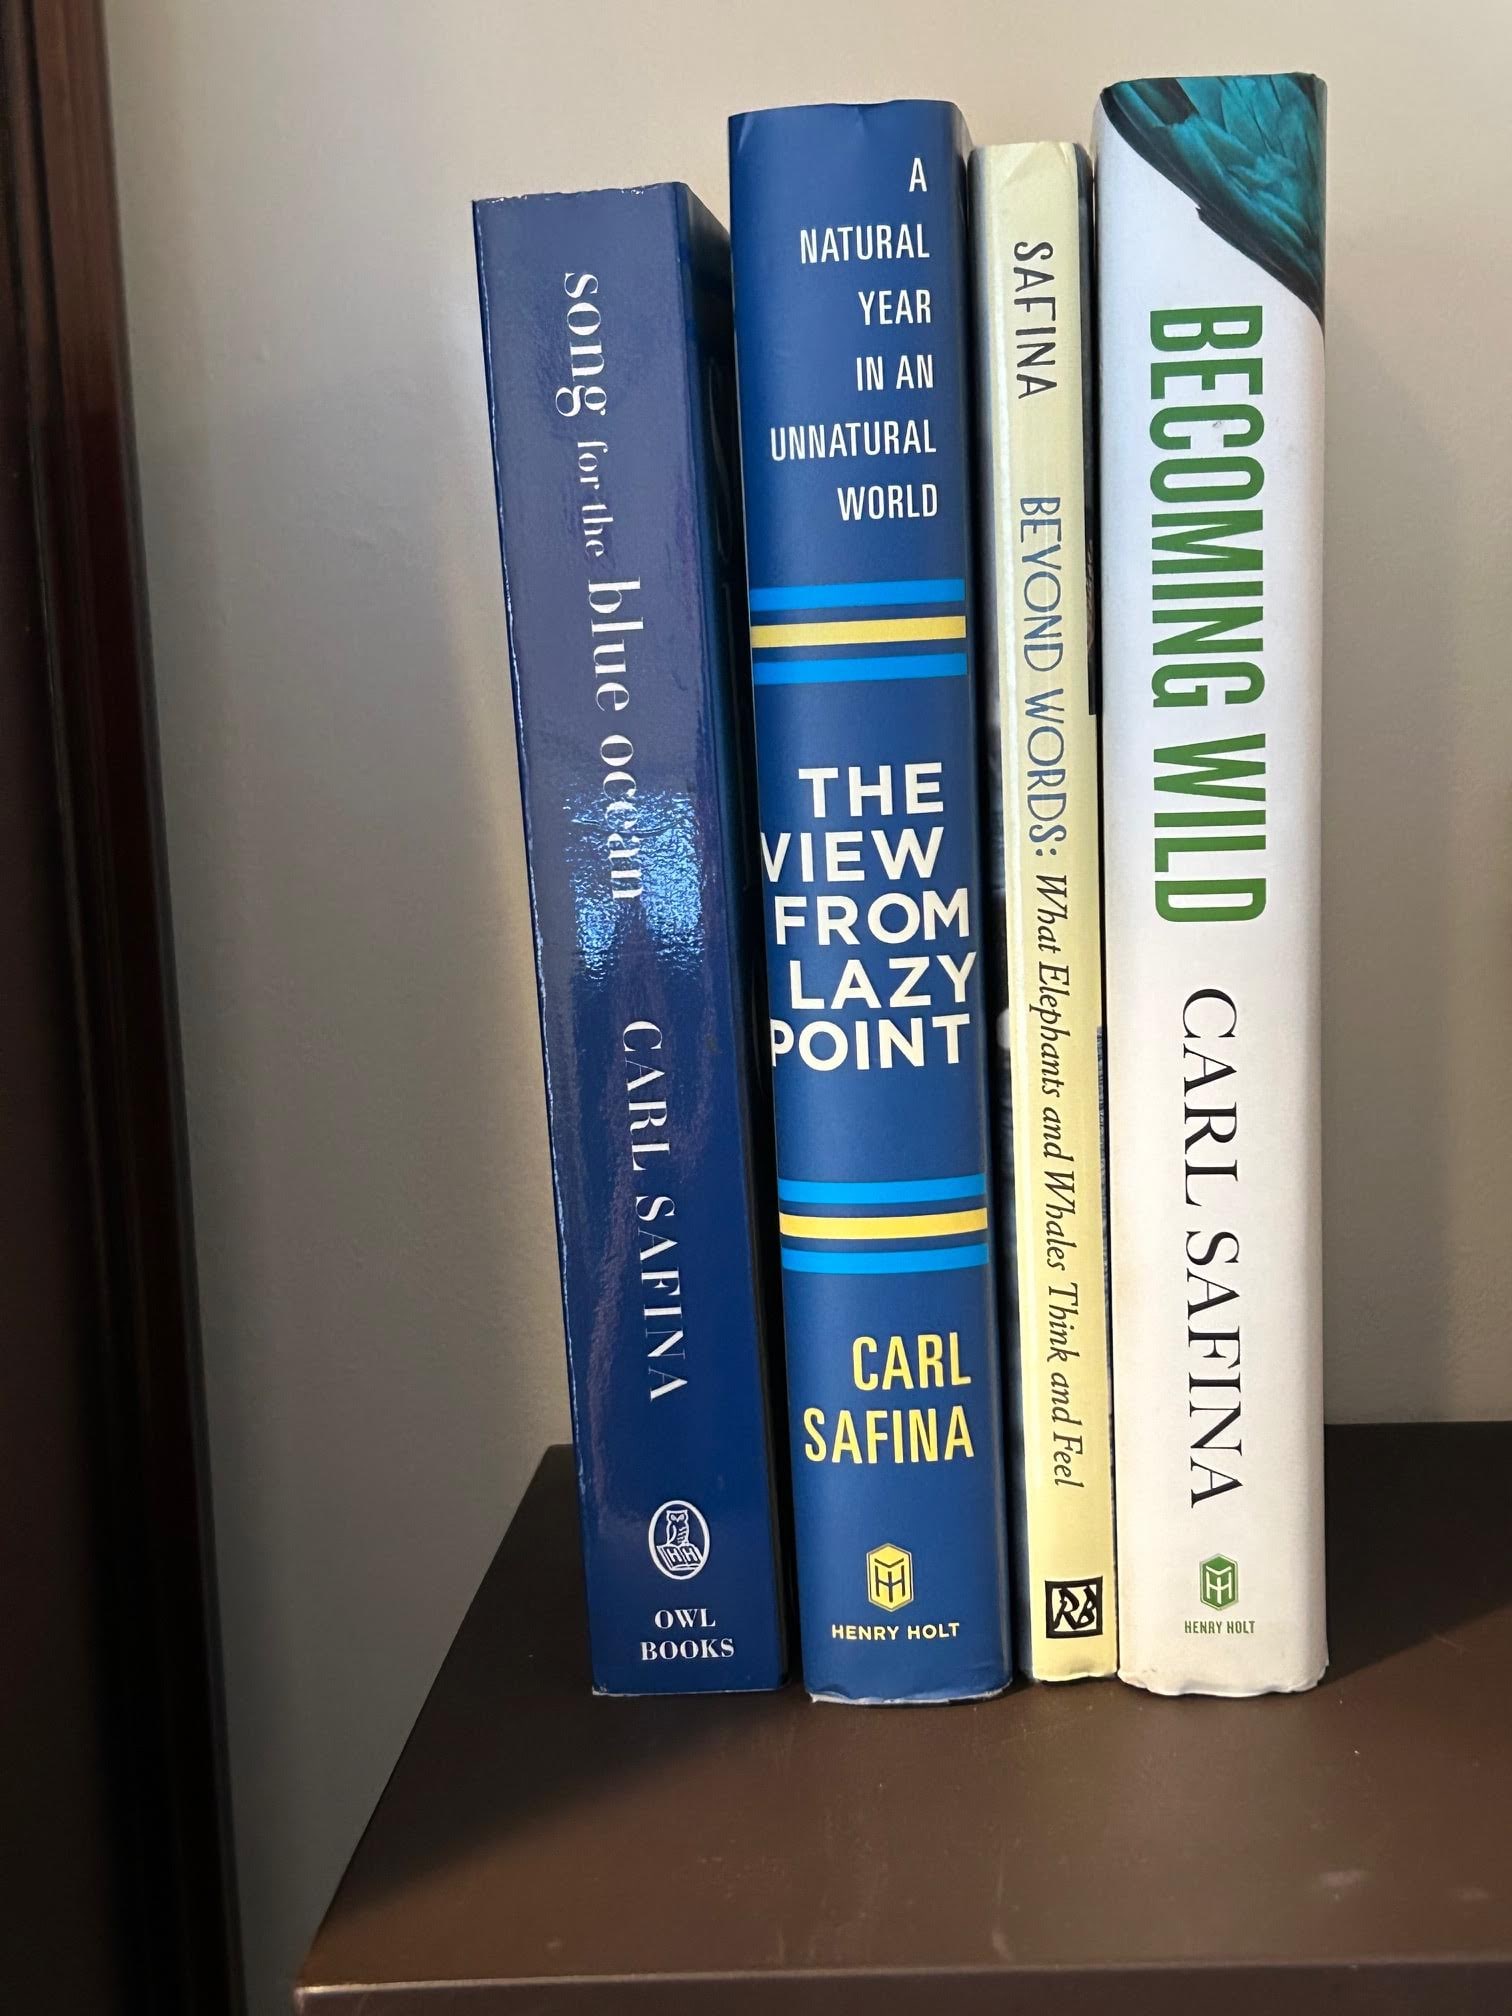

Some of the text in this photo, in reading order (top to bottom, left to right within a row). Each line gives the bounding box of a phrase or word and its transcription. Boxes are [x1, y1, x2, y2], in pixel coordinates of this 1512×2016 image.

[908, 157, 927, 193] A
[799, 224, 930, 263] NATURAL
[857, 289, 932, 325] YEAR
[1013, 240, 1058, 400] SAFINA
[855, 354, 935, 391] IN AN
[770, 420, 937, 462] UNNATURAL
[837, 482, 939, 522] WORLD
[555, 270, 644, 902] song for the blue ocean
[1149, 304, 1267, 923] BECOMING WILD
[798, 762, 944, 818] THE
[761, 826, 944, 883] VIEW
[774, 887, 970, 945] FROM
[789, 951, 977, 1010] LAZY
[1019, 496, 1084, 1489] BEYOND WORDS: What Elephants and Whales Think and Feel
[770, 1013, 970, 1071] POINT
[622, 1019, 689, 1402] CARL SAFINA
[1181, 986, 1244, 1510] CARL SAFINA
[852, 1332, 971, 1391] CARL
[803, 1405, 975, 1464] SAFINA
[653, 1607, 716, 1630] OWL
[831, 1622, 960, 1641] HENRY HOLT
[1184, 1620, 1256, 1636] HENRY HOLT
[640, 1637, 735, 1662] BOOKS
